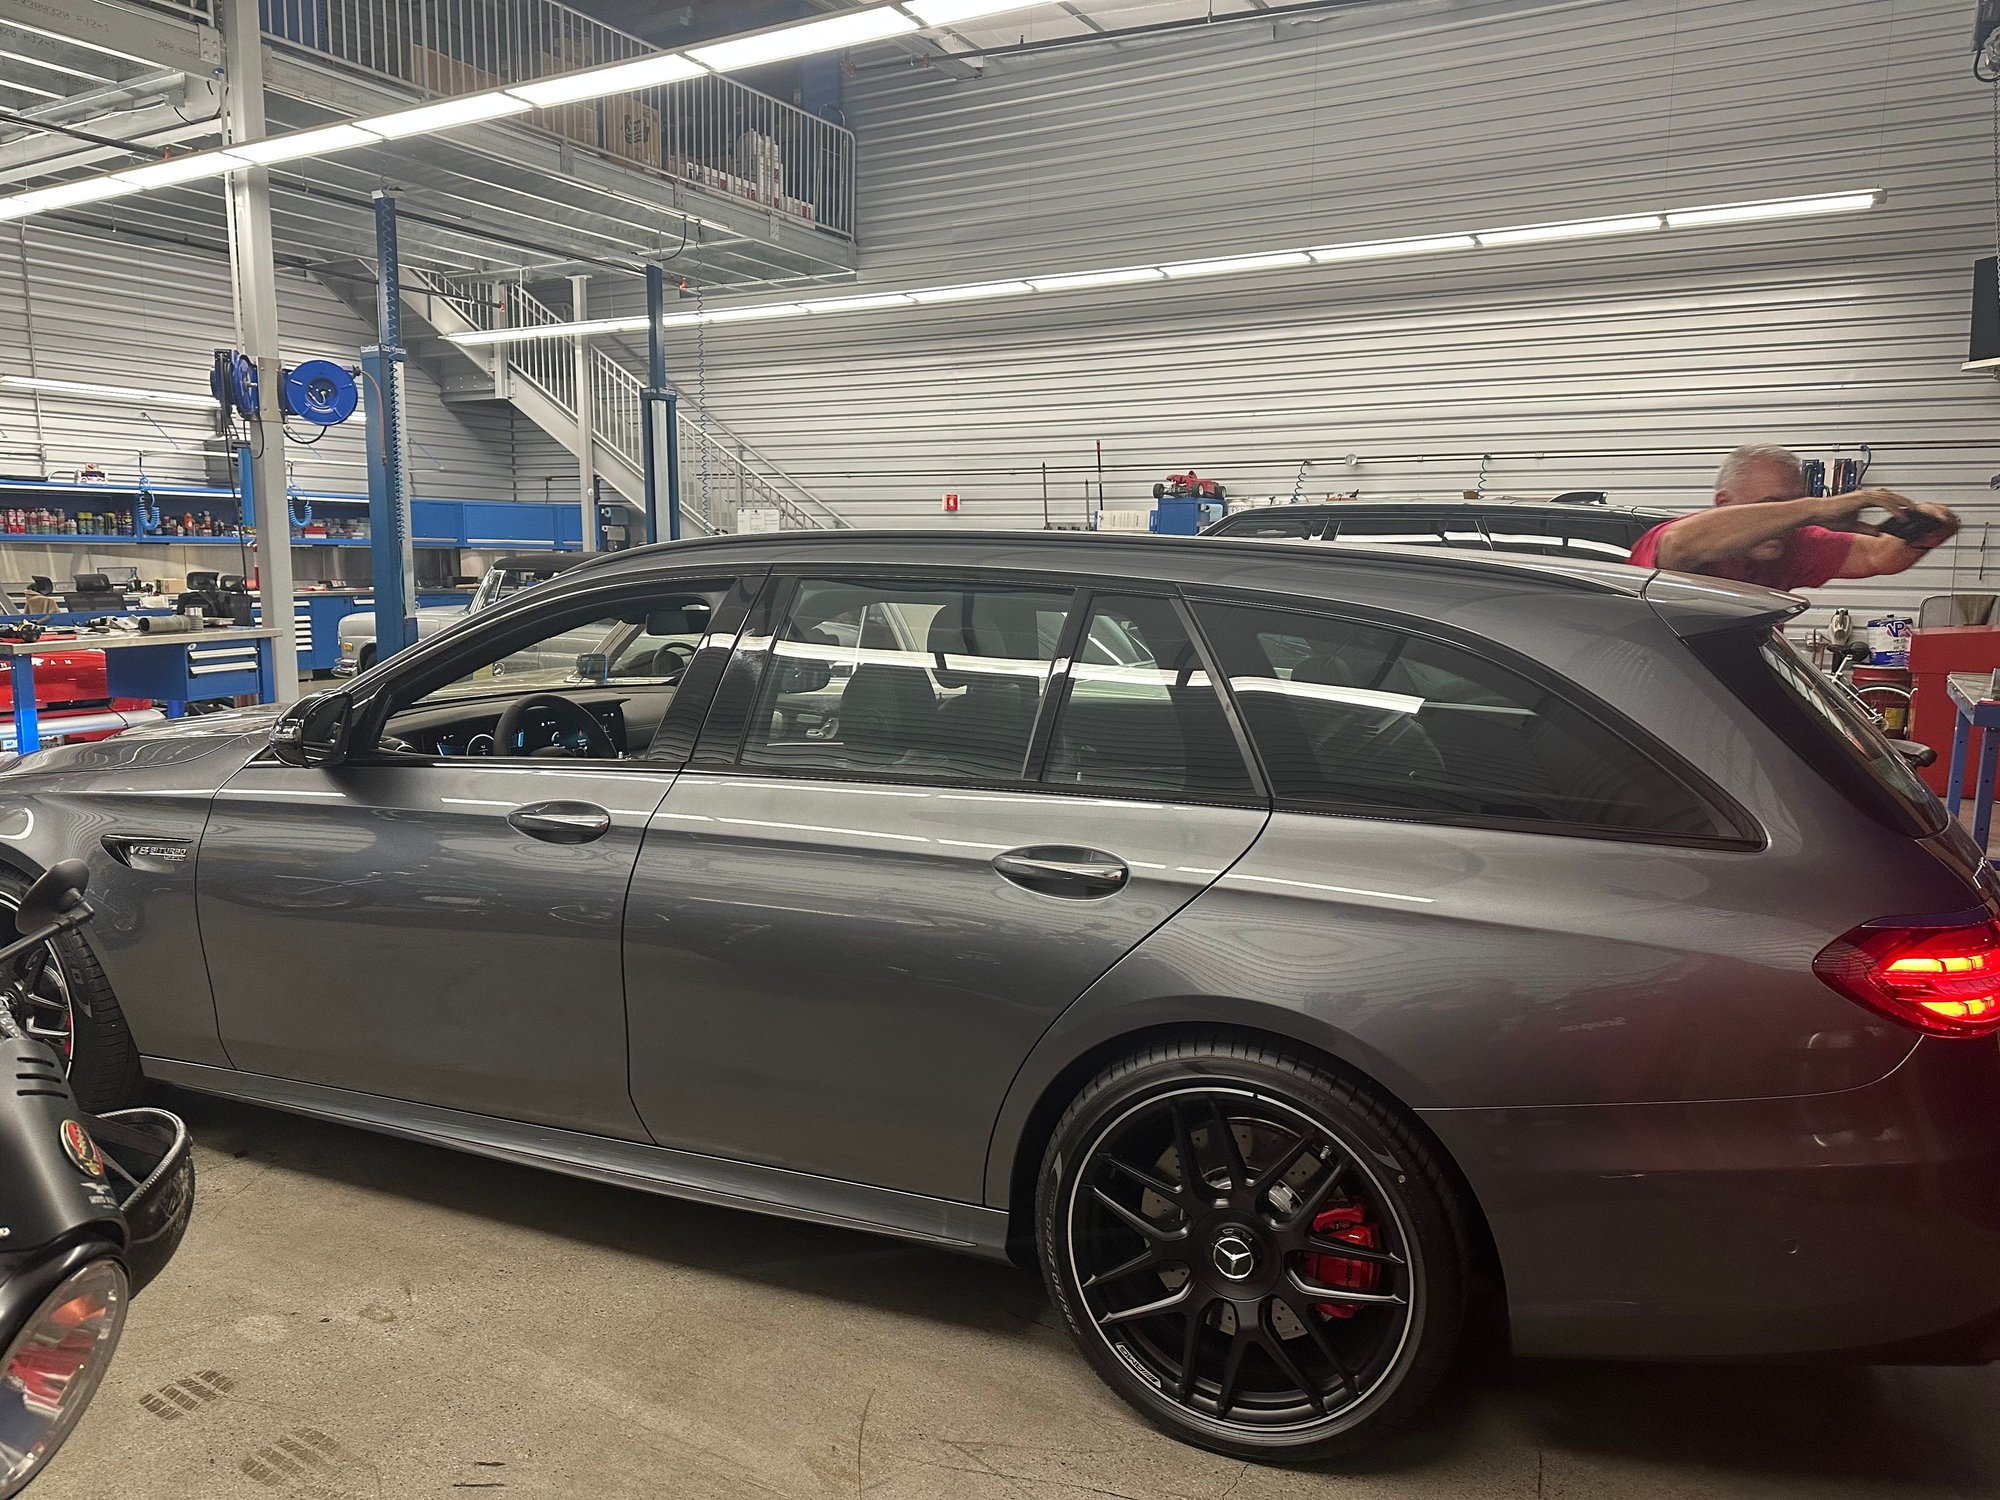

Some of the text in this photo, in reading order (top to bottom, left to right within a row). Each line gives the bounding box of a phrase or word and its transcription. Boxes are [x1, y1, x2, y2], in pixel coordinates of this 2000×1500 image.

[1886, 621, 1906, 637] VP
[130, 845, 187, 855] V8 BITURBO
